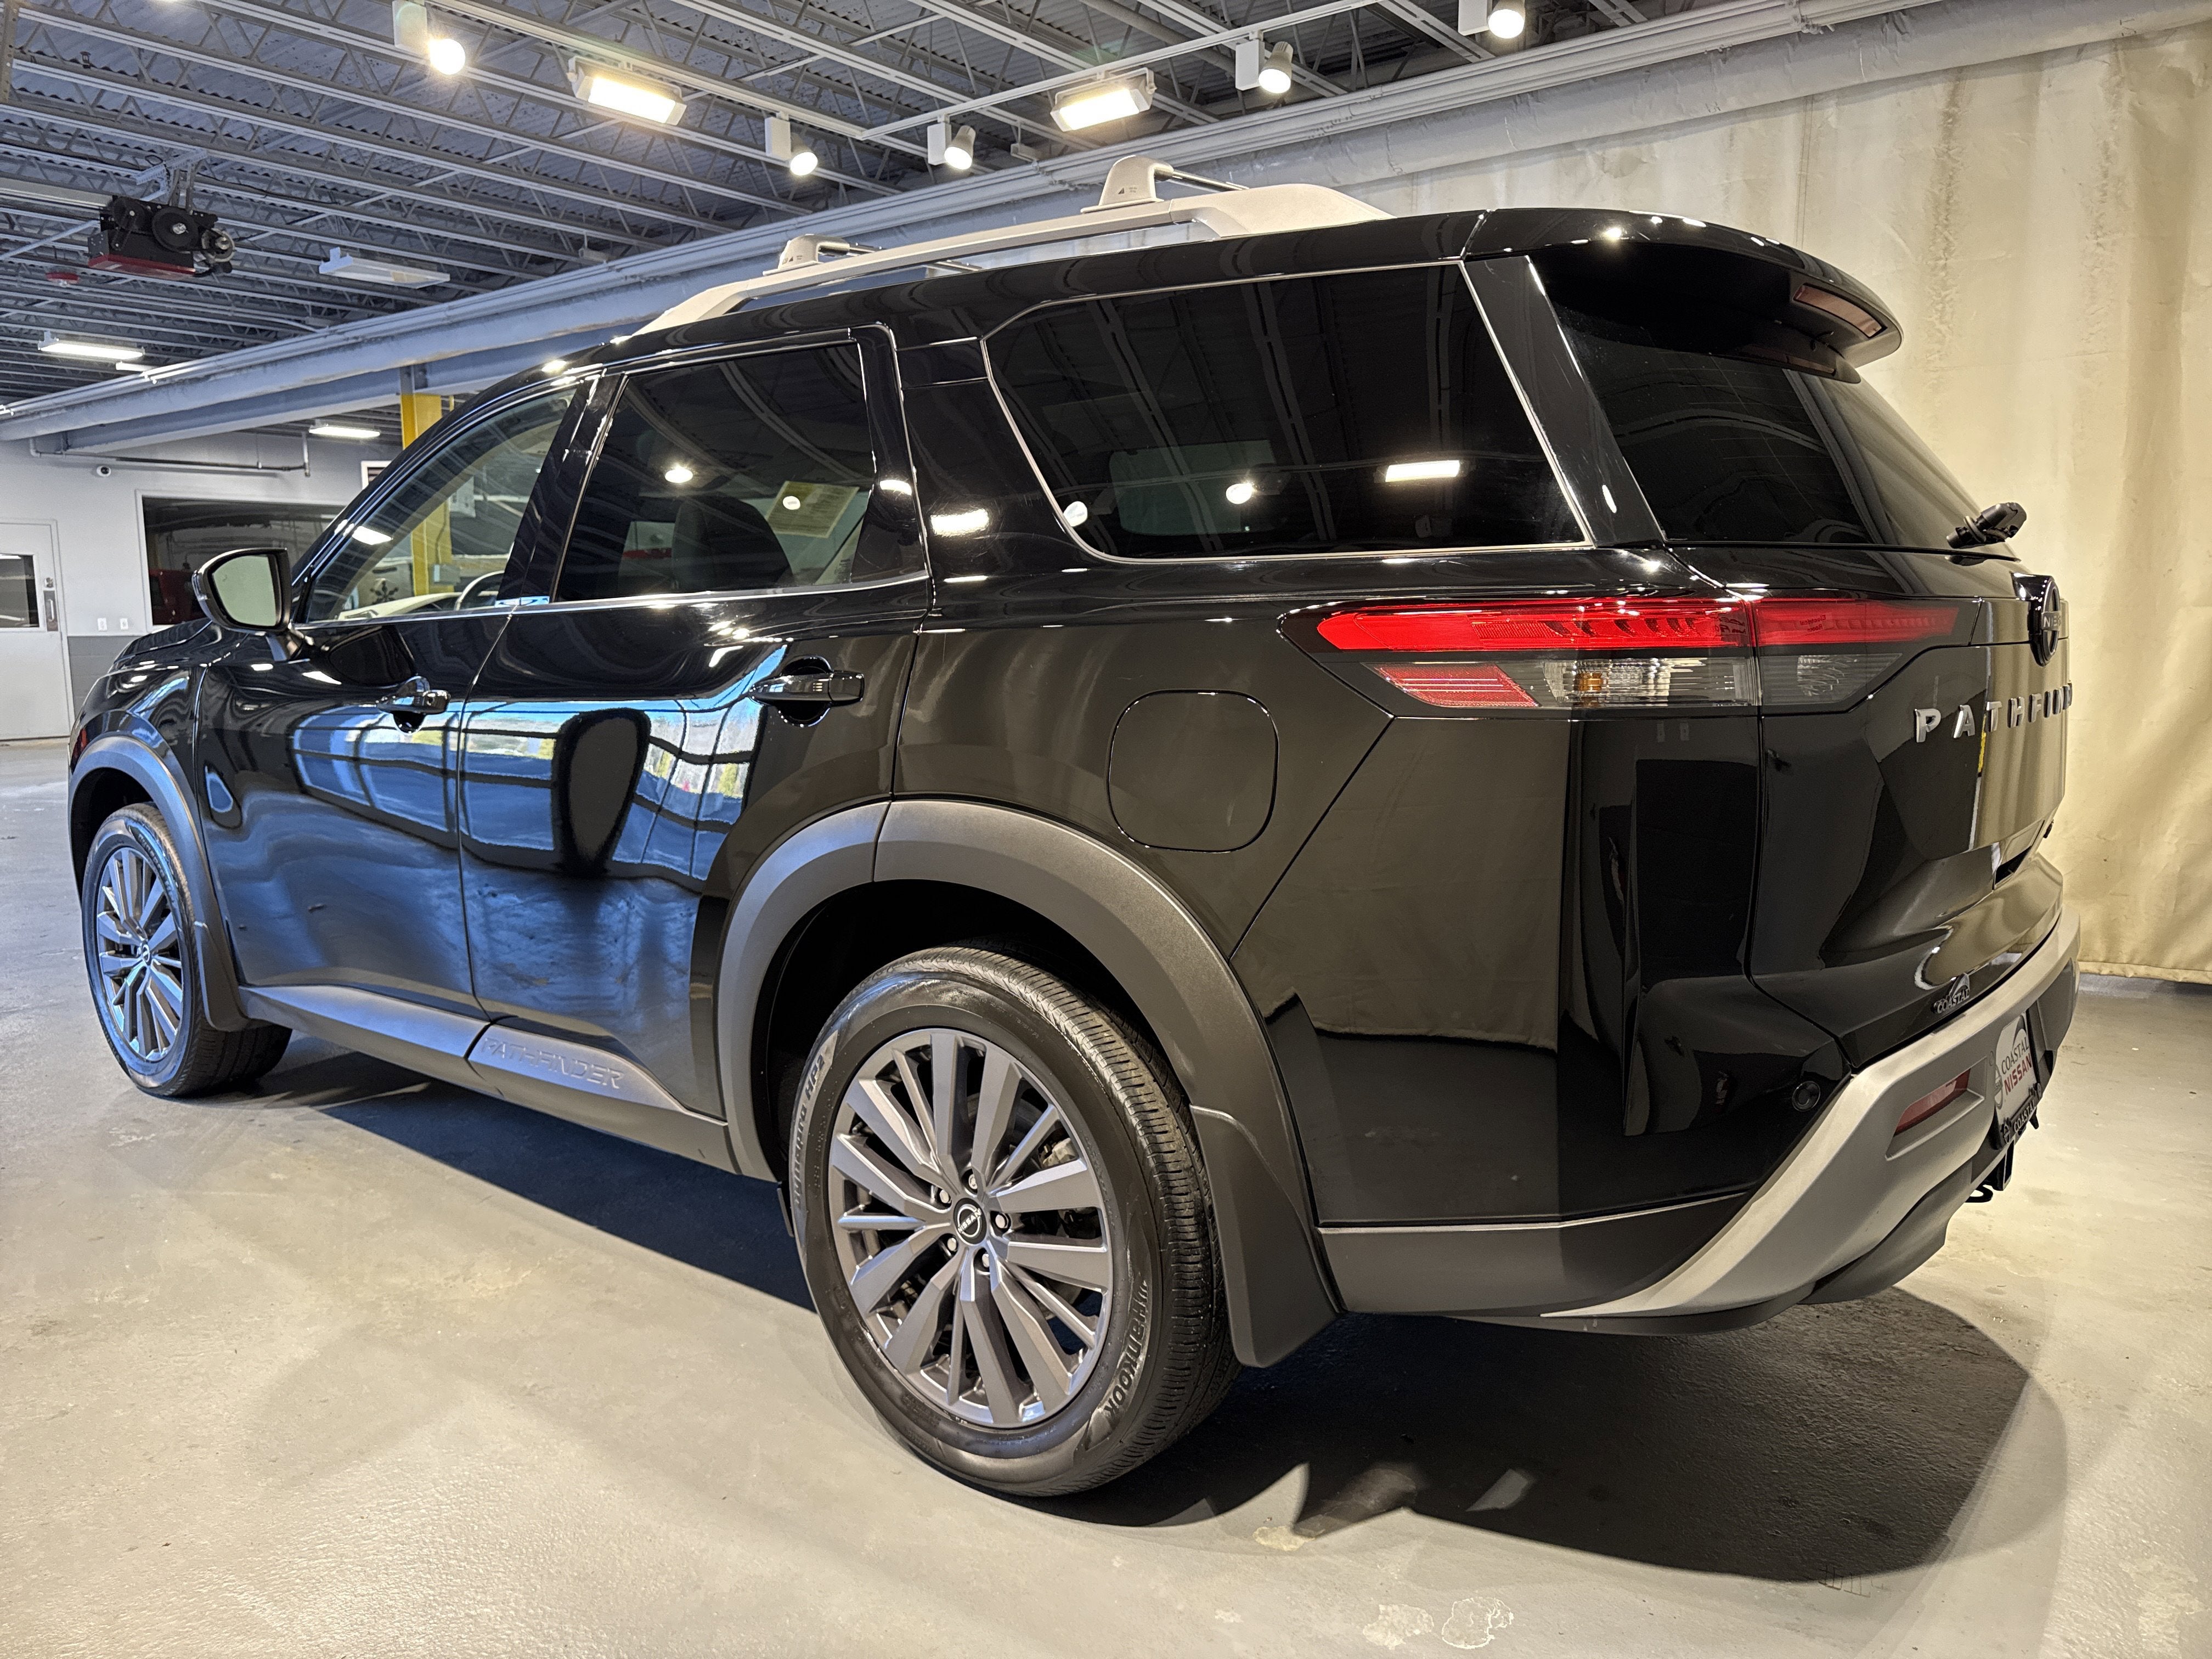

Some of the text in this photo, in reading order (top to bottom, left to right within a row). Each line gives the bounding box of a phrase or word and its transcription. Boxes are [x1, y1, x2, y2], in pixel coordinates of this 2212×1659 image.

[1937, 988, 1970, 1014] COASTAL
[481, 1036, 625, 1090] PATHFINDER
[2001, 1036, 2029, 1075] COASTAL
[2004, 1053, 2032, 1096] NISSAN
[805, 1053, 825, 1101] HP2
[957, 1207, 981, 1234] NISSAN
